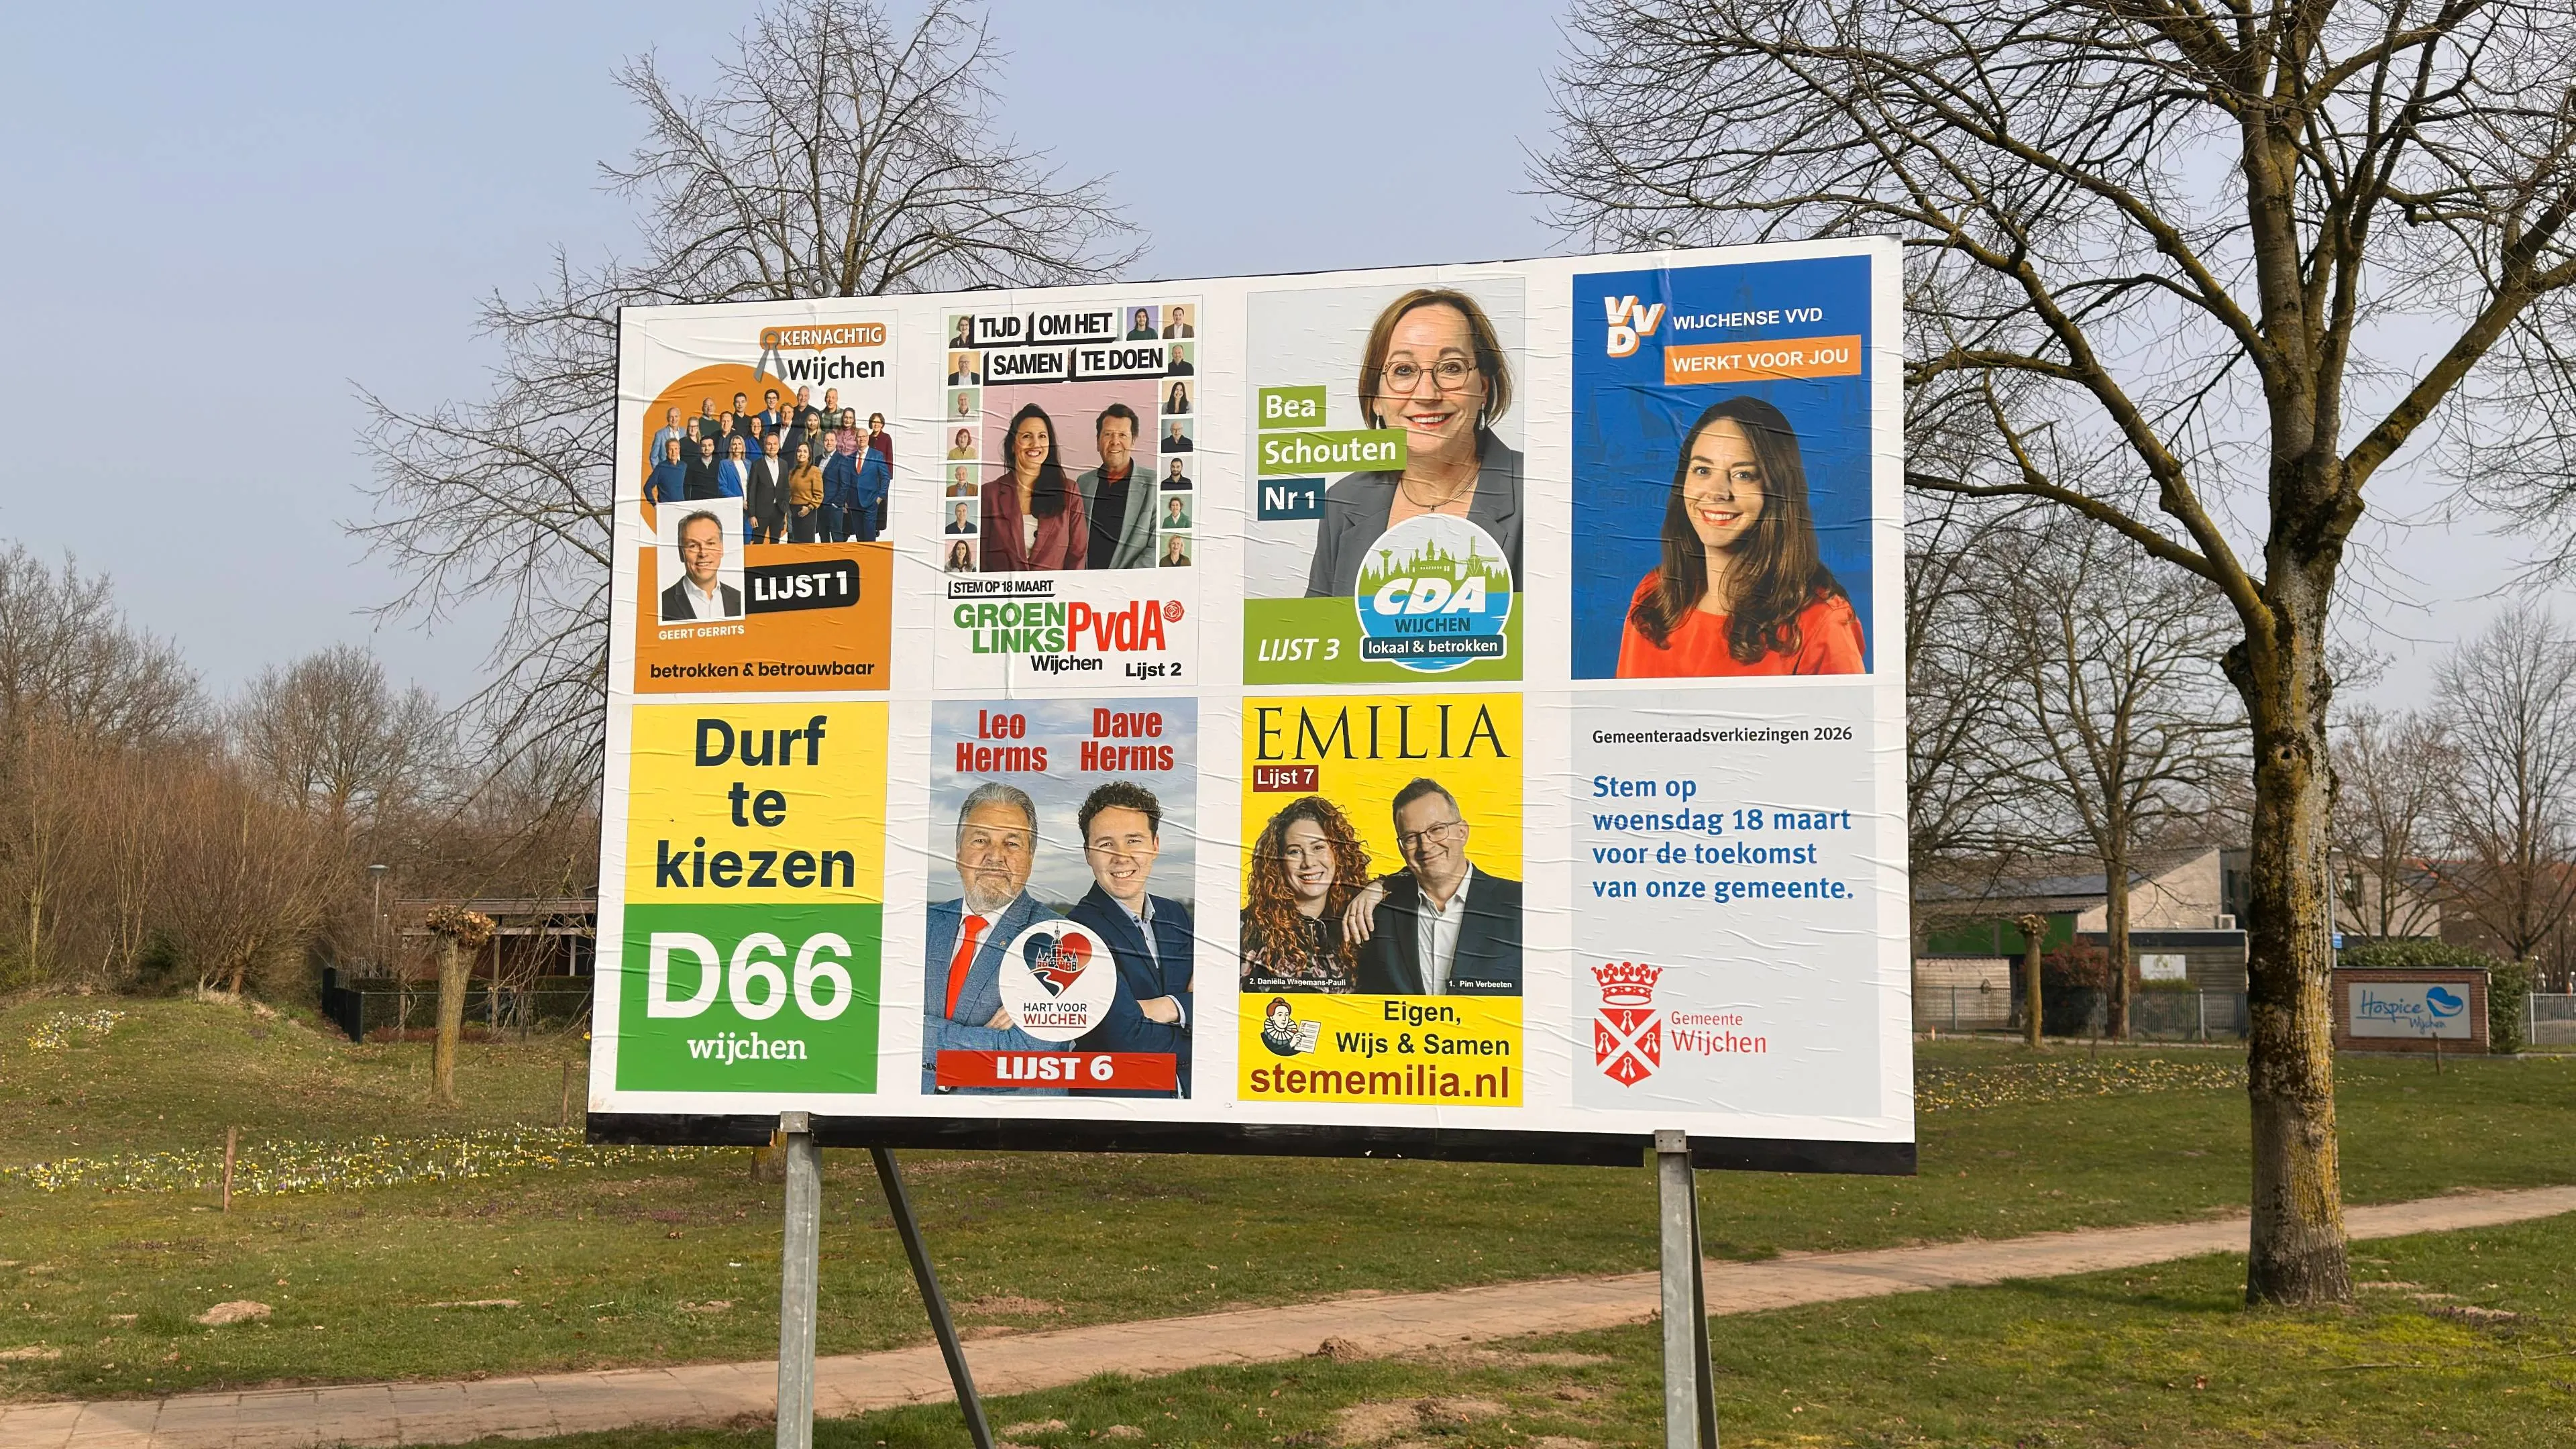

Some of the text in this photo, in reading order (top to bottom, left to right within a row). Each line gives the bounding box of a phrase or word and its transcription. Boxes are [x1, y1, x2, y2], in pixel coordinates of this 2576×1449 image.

[979, 313, 1112, 337] TIJD OM HET
[1673, 307, 1823, 330] WIJCHENSE VVD
[780, 327, 882, 346] KERNACHTIG
[788, 355, 885, 386] Wijchen
[994, 347, 1163, 375] SAMEN TE DOEN
[1673, 348, 1848, 372] WERKT VOOR JOU
[1266, 394, 1316, 418] Bea
[1265, 437, 1396, 464] Schouten
[1265, 486, 1315, 510] Nr 1
[755, 571, 847, 601] LIJST 1
[954, 580, 1053, 593] STEM OP 18 MAART
[1373, 576, 1486, 615] CDA
[953, 602, 1066, 629] GROEN
[1067, 600, 1166, 651] PvdA
[1395, 618, 1470, 633] WIJCHEN
[658, 625, 745, 640] GEERT GERRITS
[973, 627, 1065, 654] LINKS
[1258, 638, 1340, 661] LIJST 3
[1368, 639, 1497, 653] lokaal & betrokken
[651, 661, 875, 678] betrokken & betrouwbaar
[1030, 655, 1103, 675] Wijchen
[1126, 662, 1181, 680] Lijst 2
[979, 710, 1026, 739] Leo
[1093, 708, 1163, 738] Dave
[1254, 703, 1511, 760] EMILIA
[1593, 727, 1852, 744] Gemeenteraadsverkiezingen 2026
[695, 715, 827, 767] Durf
[956, 742, 1047, 771] Herms
[1081, 741, 1174, 771] Herms
[1257, 769, 1314, 788] Lijst 7
[1593, 775, 1697, 802] Stem op
[728, 782, 786, 827] te
[1593, 808, 1851, 835] woensdag 18 maart
[656, 837, 855, 888] kiezen
[1593, 841, 1817, 865] voor de toekomst
[1593, 877, 1854, 904] van onze gemeente.
[647, 932, 853, 1020] D66
[1287, 978, 1346, 986] Wagemans-Pauli
[1024, 1003, 1087, 1012] HART VOOR
[1385, 1001, 1462, 1026] Eigen,
[1671, 1010, 1743, 1026] Gemeente
[2361, 989, 2424, 1023] Hospice
[1024, 1014, 1086, 1025] WIJCHEN
[687, 1032, 807, 1065] wijchen
[1336, 1032, 1509, 1058] Wijs & Samen
[1671, 1029, 1766, 1056] Wijchen
[997, 1055, 1114, 1081] LIJST 6
[1250, 1063, 1509, 1098] stememilia.nl
